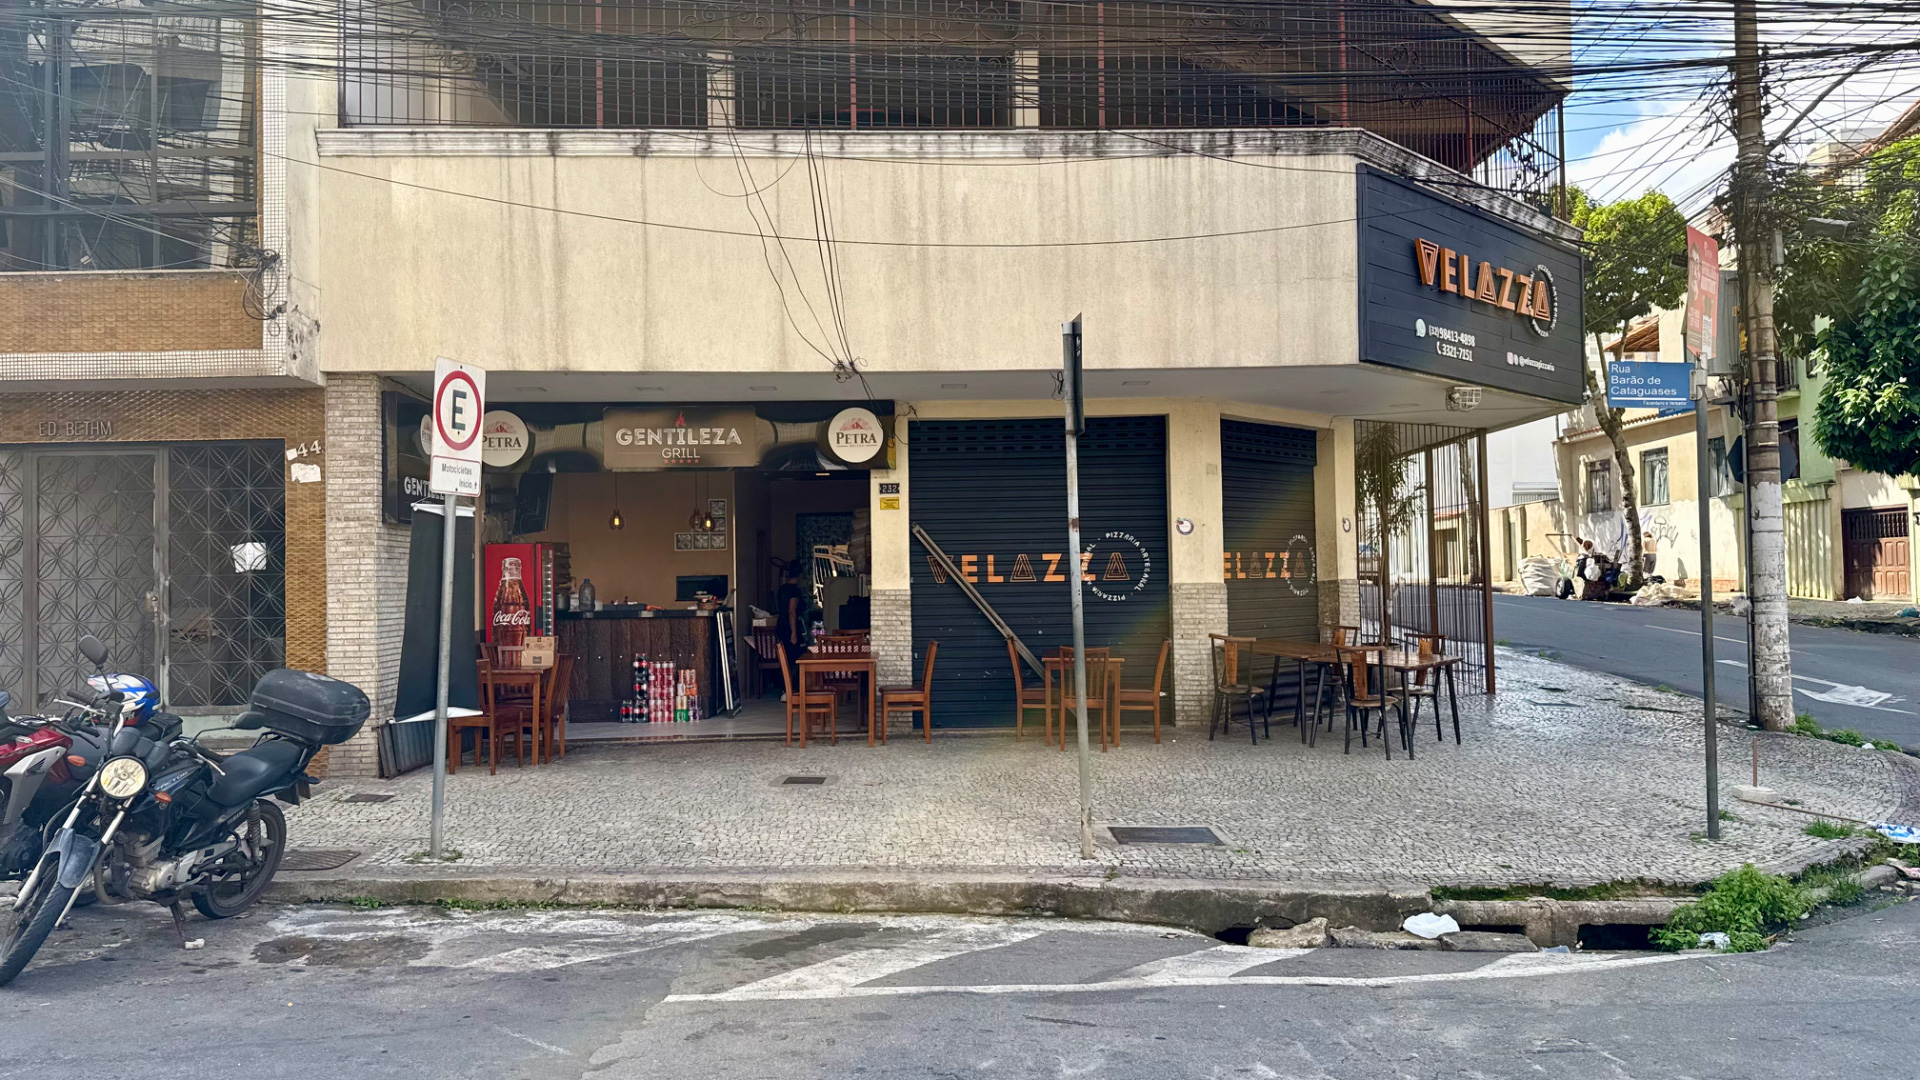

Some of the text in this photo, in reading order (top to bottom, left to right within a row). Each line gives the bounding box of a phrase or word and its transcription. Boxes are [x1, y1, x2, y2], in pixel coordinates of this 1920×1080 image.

[1415, 238, 1551, 321] VELAZZA
[1441, 343, 1473, 362] 3321-7151
[1611, 363, 1631, 373] Rua
[1611, 375, 1661, 385] Barão de
[1610, 386, 1677, 397] Cataguases
[452, 389, 467, 431] E
[38, 420, 112, 436] ED. BETHM
[615, 427, 742, 446] GENTILEZA
[836, 431, 877, 445] PETRA
[662, 447, 701, 459] GRILL
[441, 462, 472, 476] Motocicletas
[882, 484, 898, 493] 232
[926, 552, 1131, 584] VELAZZA
[1105, 531, 1151, 591] PIZZARIA ARTESANAL
[1223, 551, 1308, 579] ELAZZA
[493, 609, 531, 627] Coca-Cola
